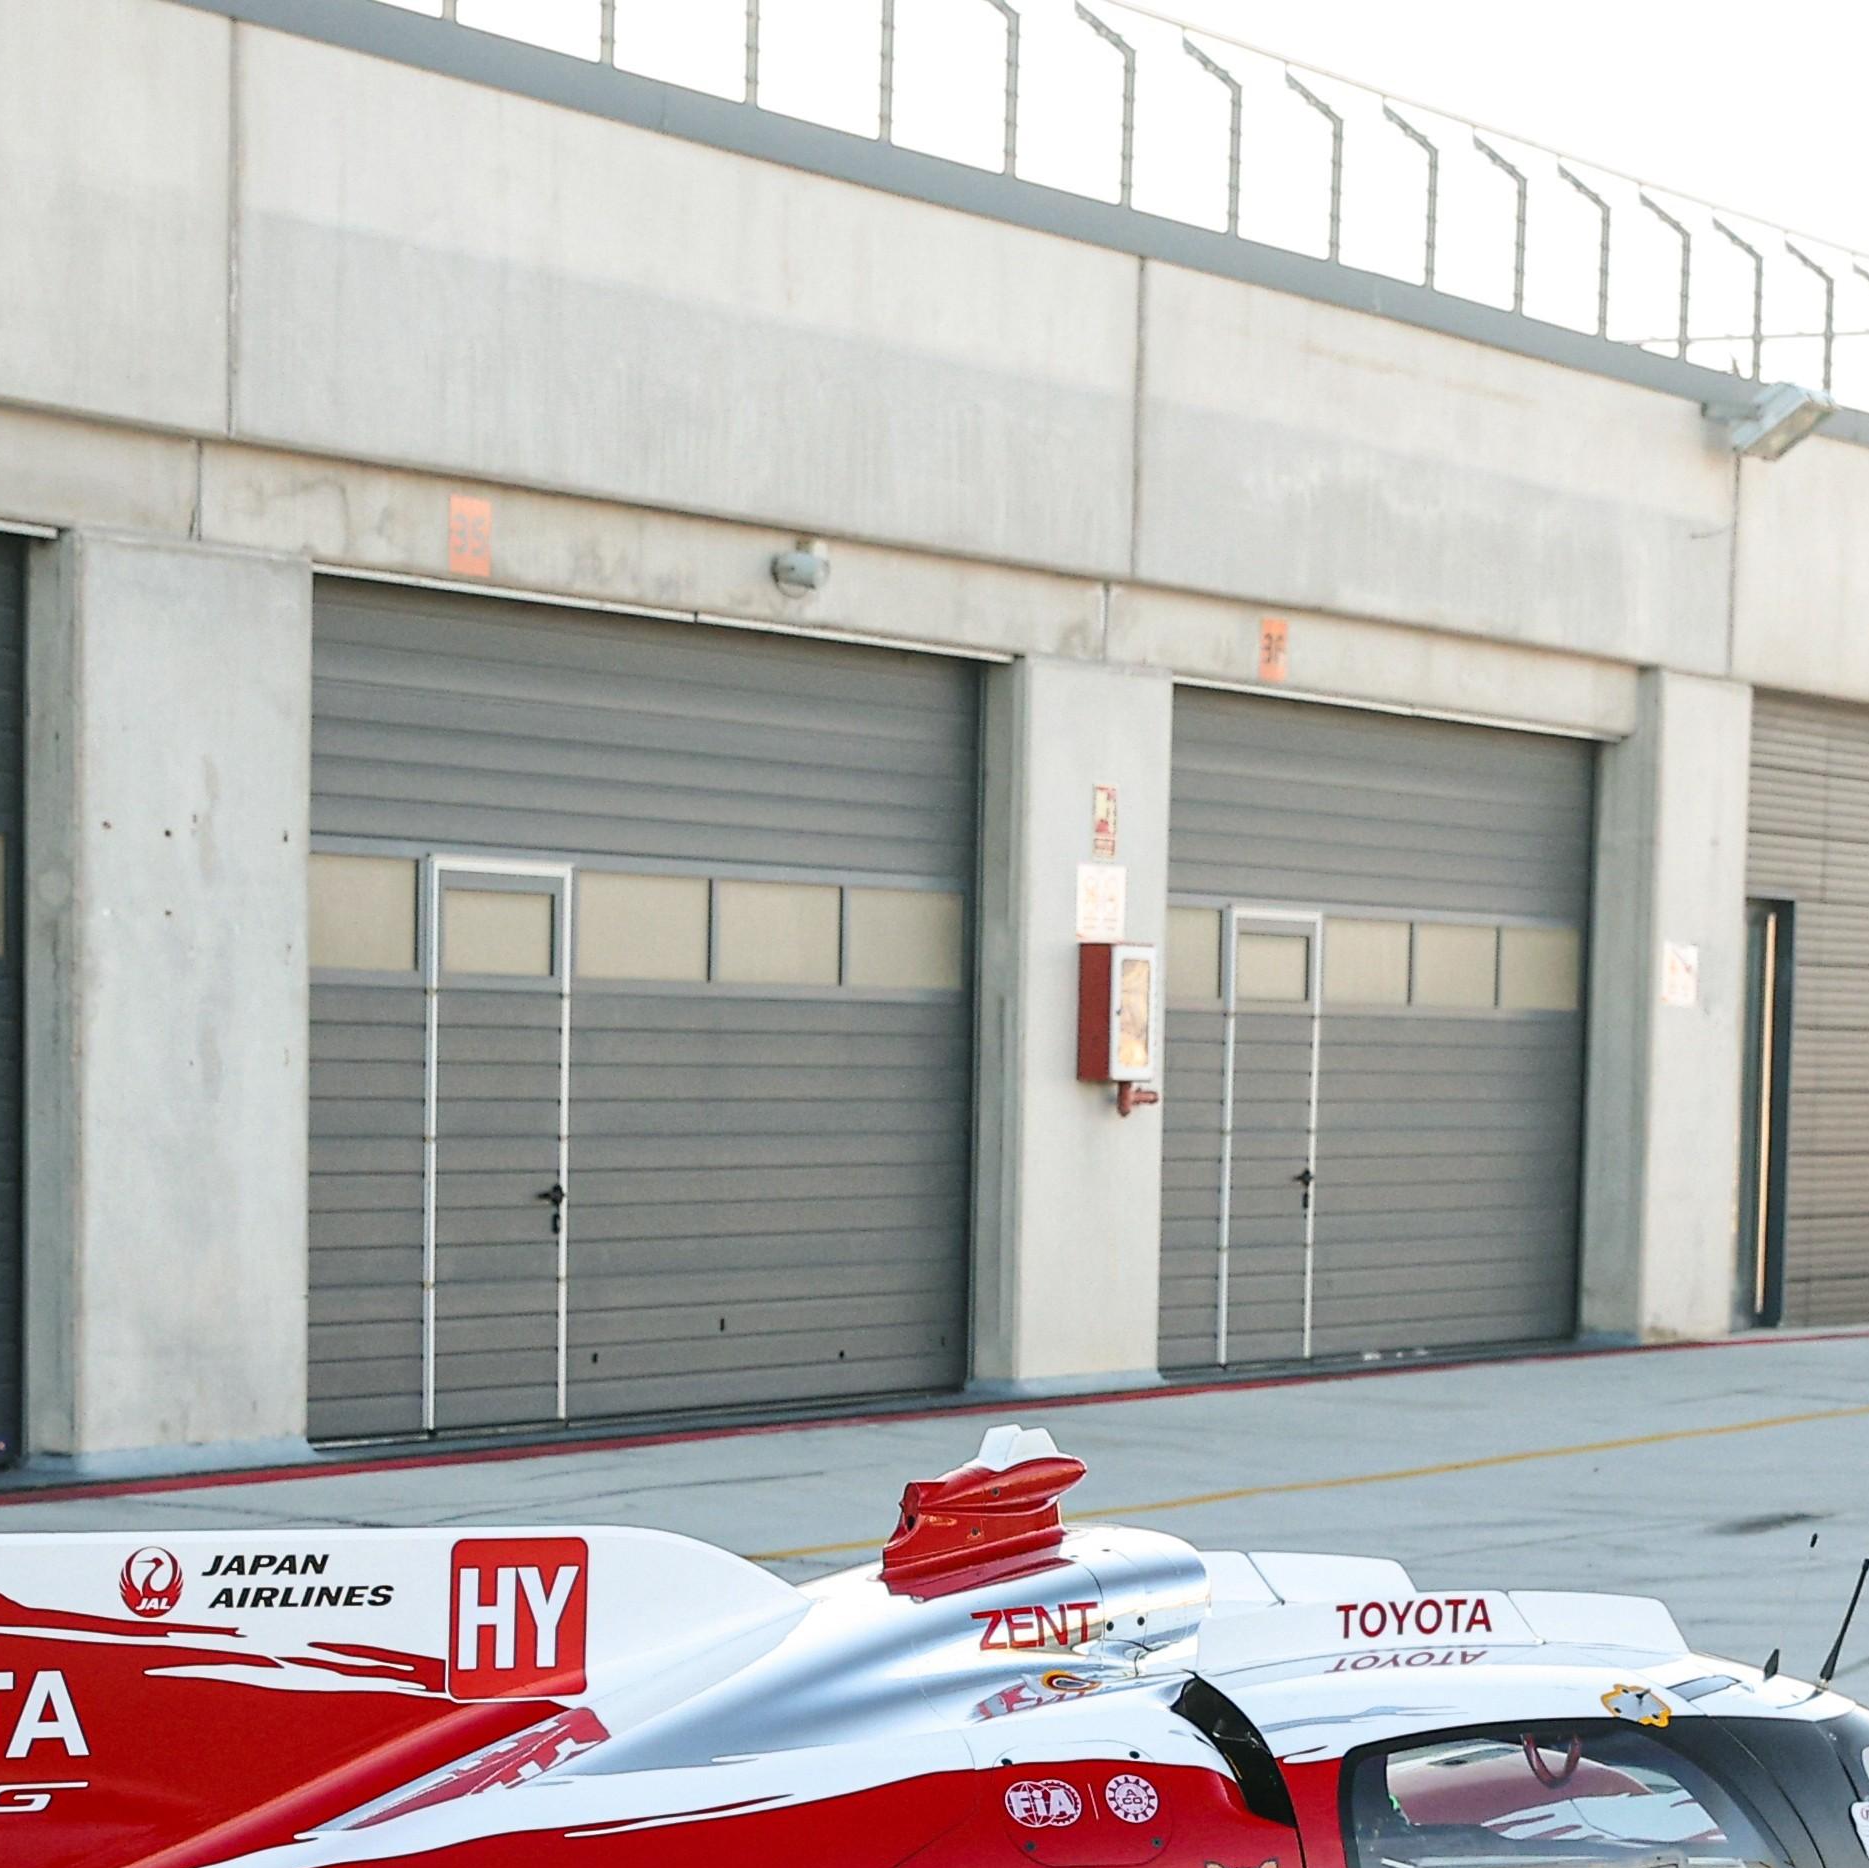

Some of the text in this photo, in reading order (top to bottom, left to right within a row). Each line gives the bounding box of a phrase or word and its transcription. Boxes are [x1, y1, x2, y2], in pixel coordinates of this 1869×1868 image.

[201, 1553, 330, 1577] JAPAN
[135, 1597, 172, 1611] JAL
[208, 1584, 395, 1609] AIRLINES
[457, 1565, 580, 1671] HY
[970, 1601, 1099, 1652] ZENT
[1336, 1598, 1493, 1640] TOYOTA
